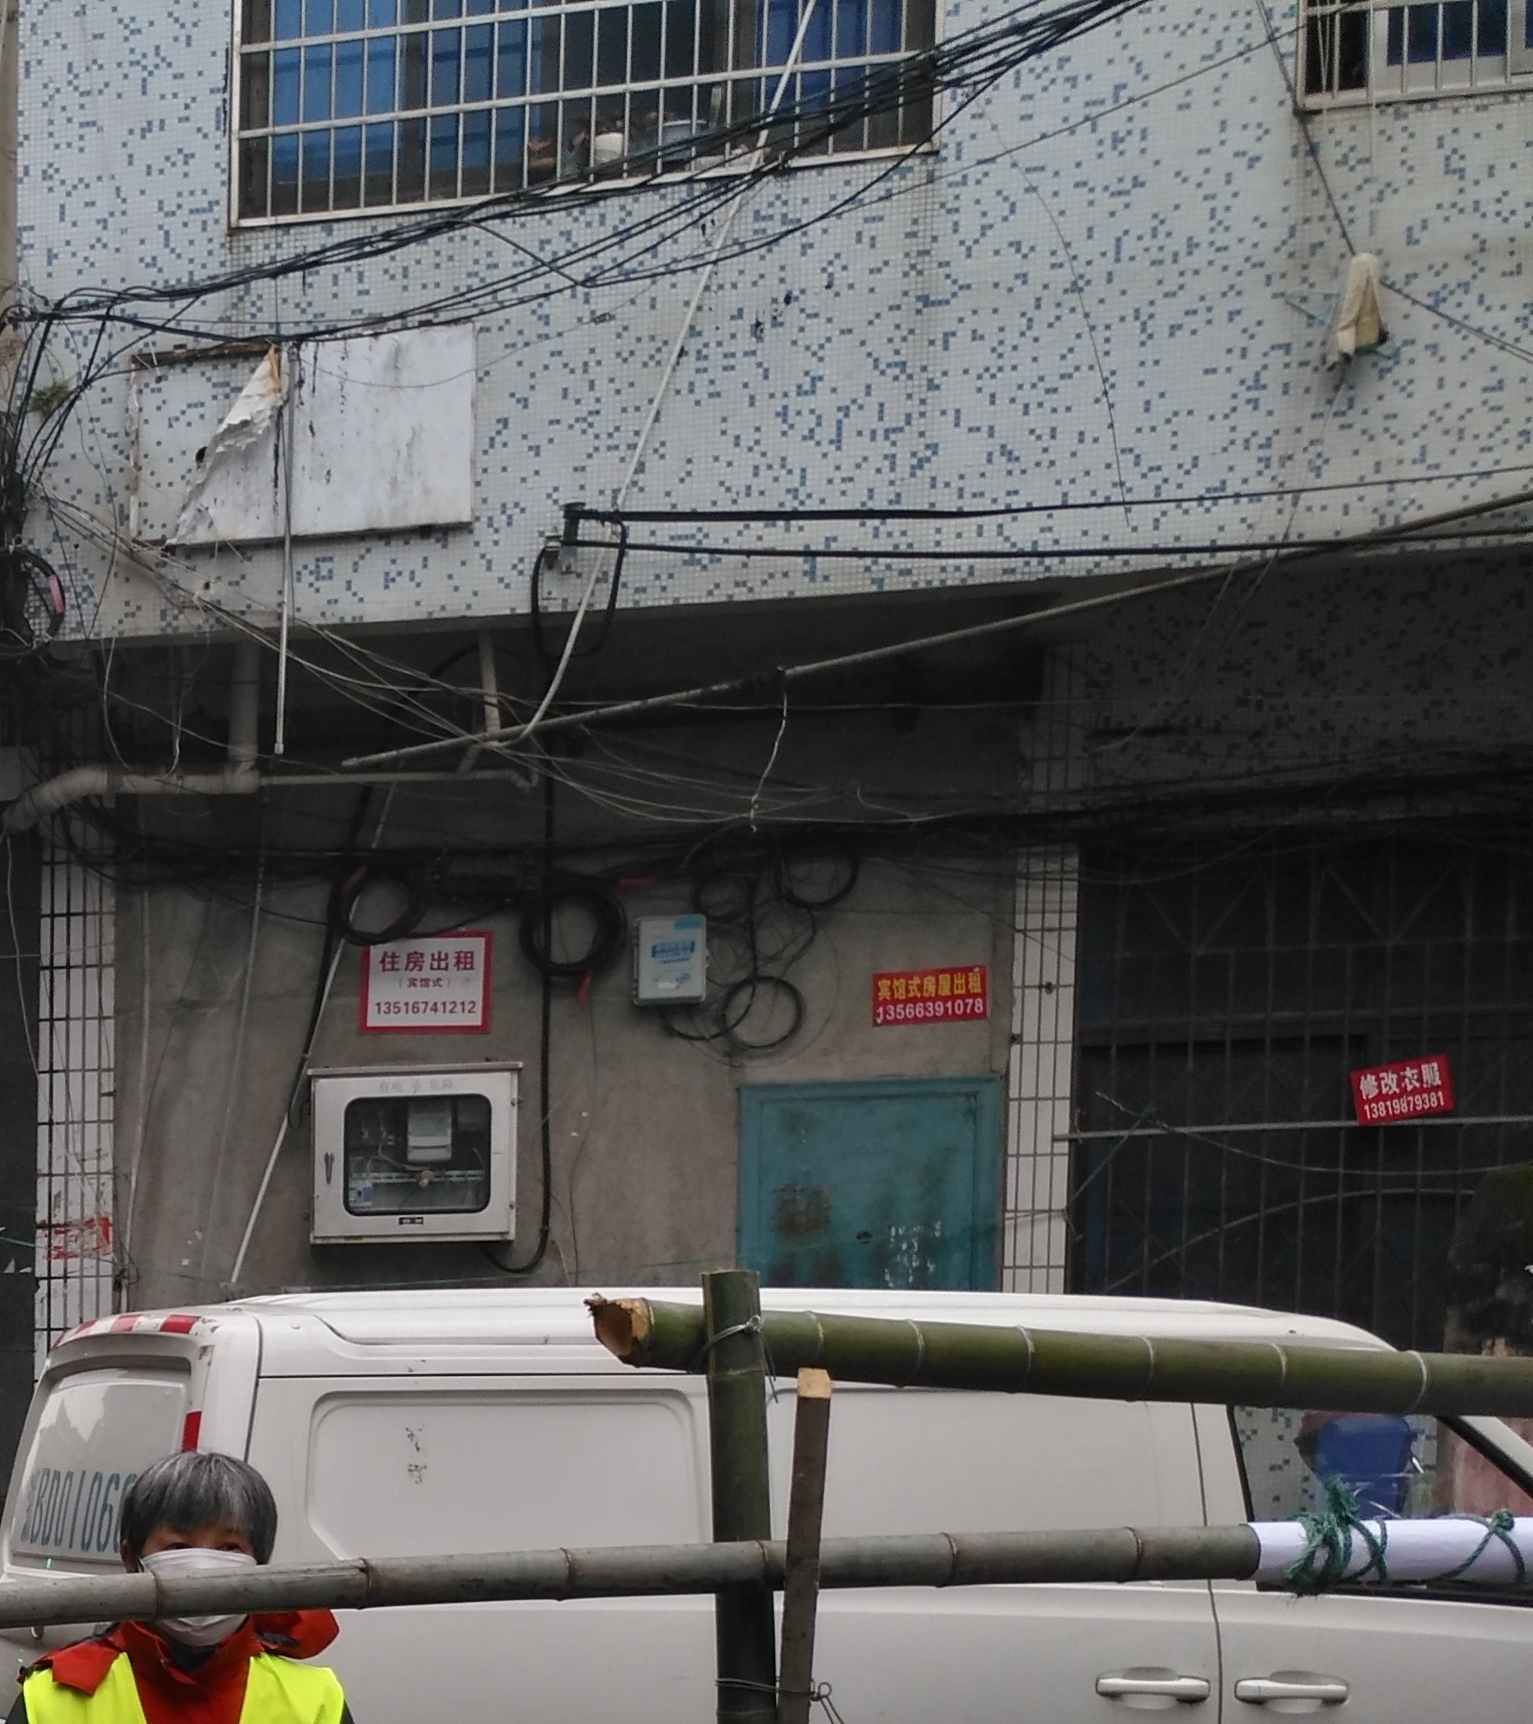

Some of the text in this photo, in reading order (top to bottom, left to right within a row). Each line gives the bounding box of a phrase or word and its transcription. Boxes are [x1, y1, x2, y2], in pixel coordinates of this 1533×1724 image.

[379, 950, 476, 973] 住房出租
[876, 966, 985, 1002] 宾馆式房屋出租
[374, 1000, 477, 1016] 13516741212
[876, 996, 985, 1024] 13566391078
[1358, 1061, 1443, 1101] 修改衣服
